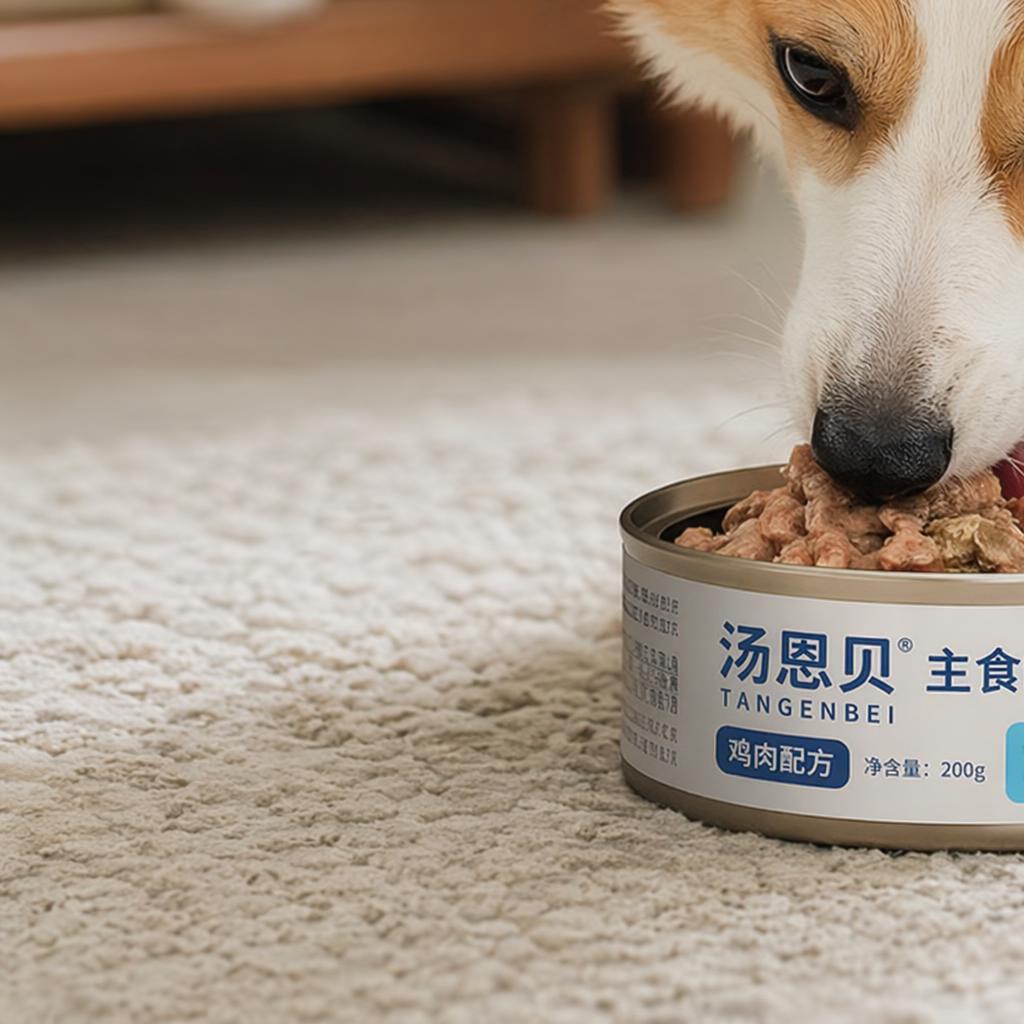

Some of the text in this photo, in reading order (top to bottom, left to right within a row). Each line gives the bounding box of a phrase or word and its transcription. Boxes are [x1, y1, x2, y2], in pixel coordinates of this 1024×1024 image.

[719, 687, 895, 724] TANGENBEI
[727, 737, 835, 778] 鸡肉配方
